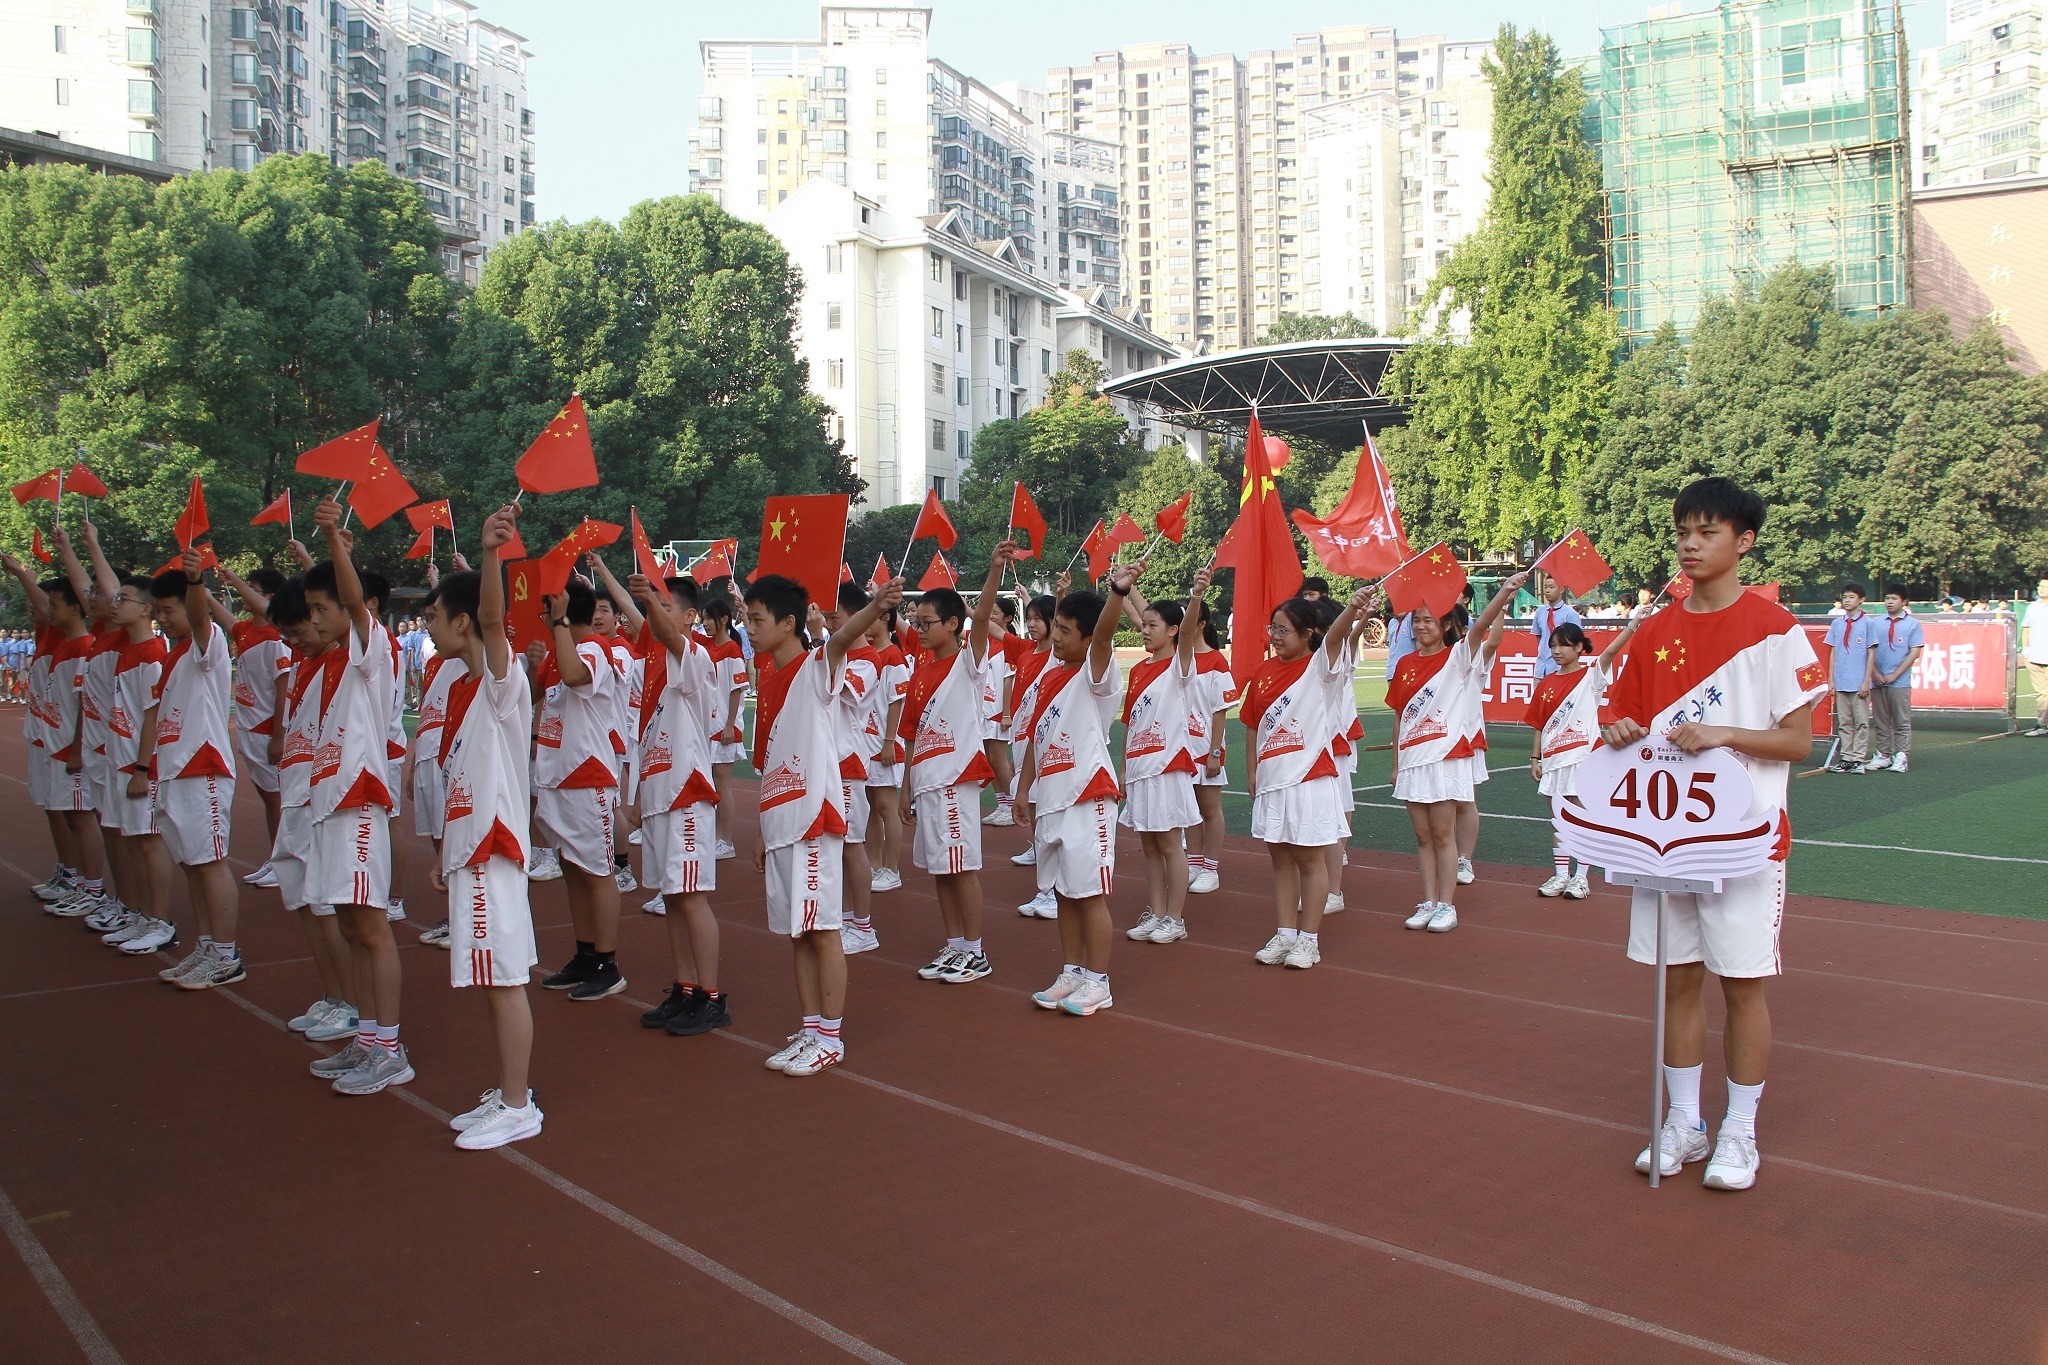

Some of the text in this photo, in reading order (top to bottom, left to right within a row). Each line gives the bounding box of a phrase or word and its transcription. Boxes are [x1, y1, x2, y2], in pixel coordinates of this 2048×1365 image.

[1910, 643, 1975, 690] 体质
[1609, 768, 1717, 823] 405
[357, 822, 371, 863] CHINA
[683, 817, 696, 852] CHINA
[948, 807, 961, 839] CHINA
[807, 851, 819, 891] CHINA
[473, 892, 487, 939] CHINA
